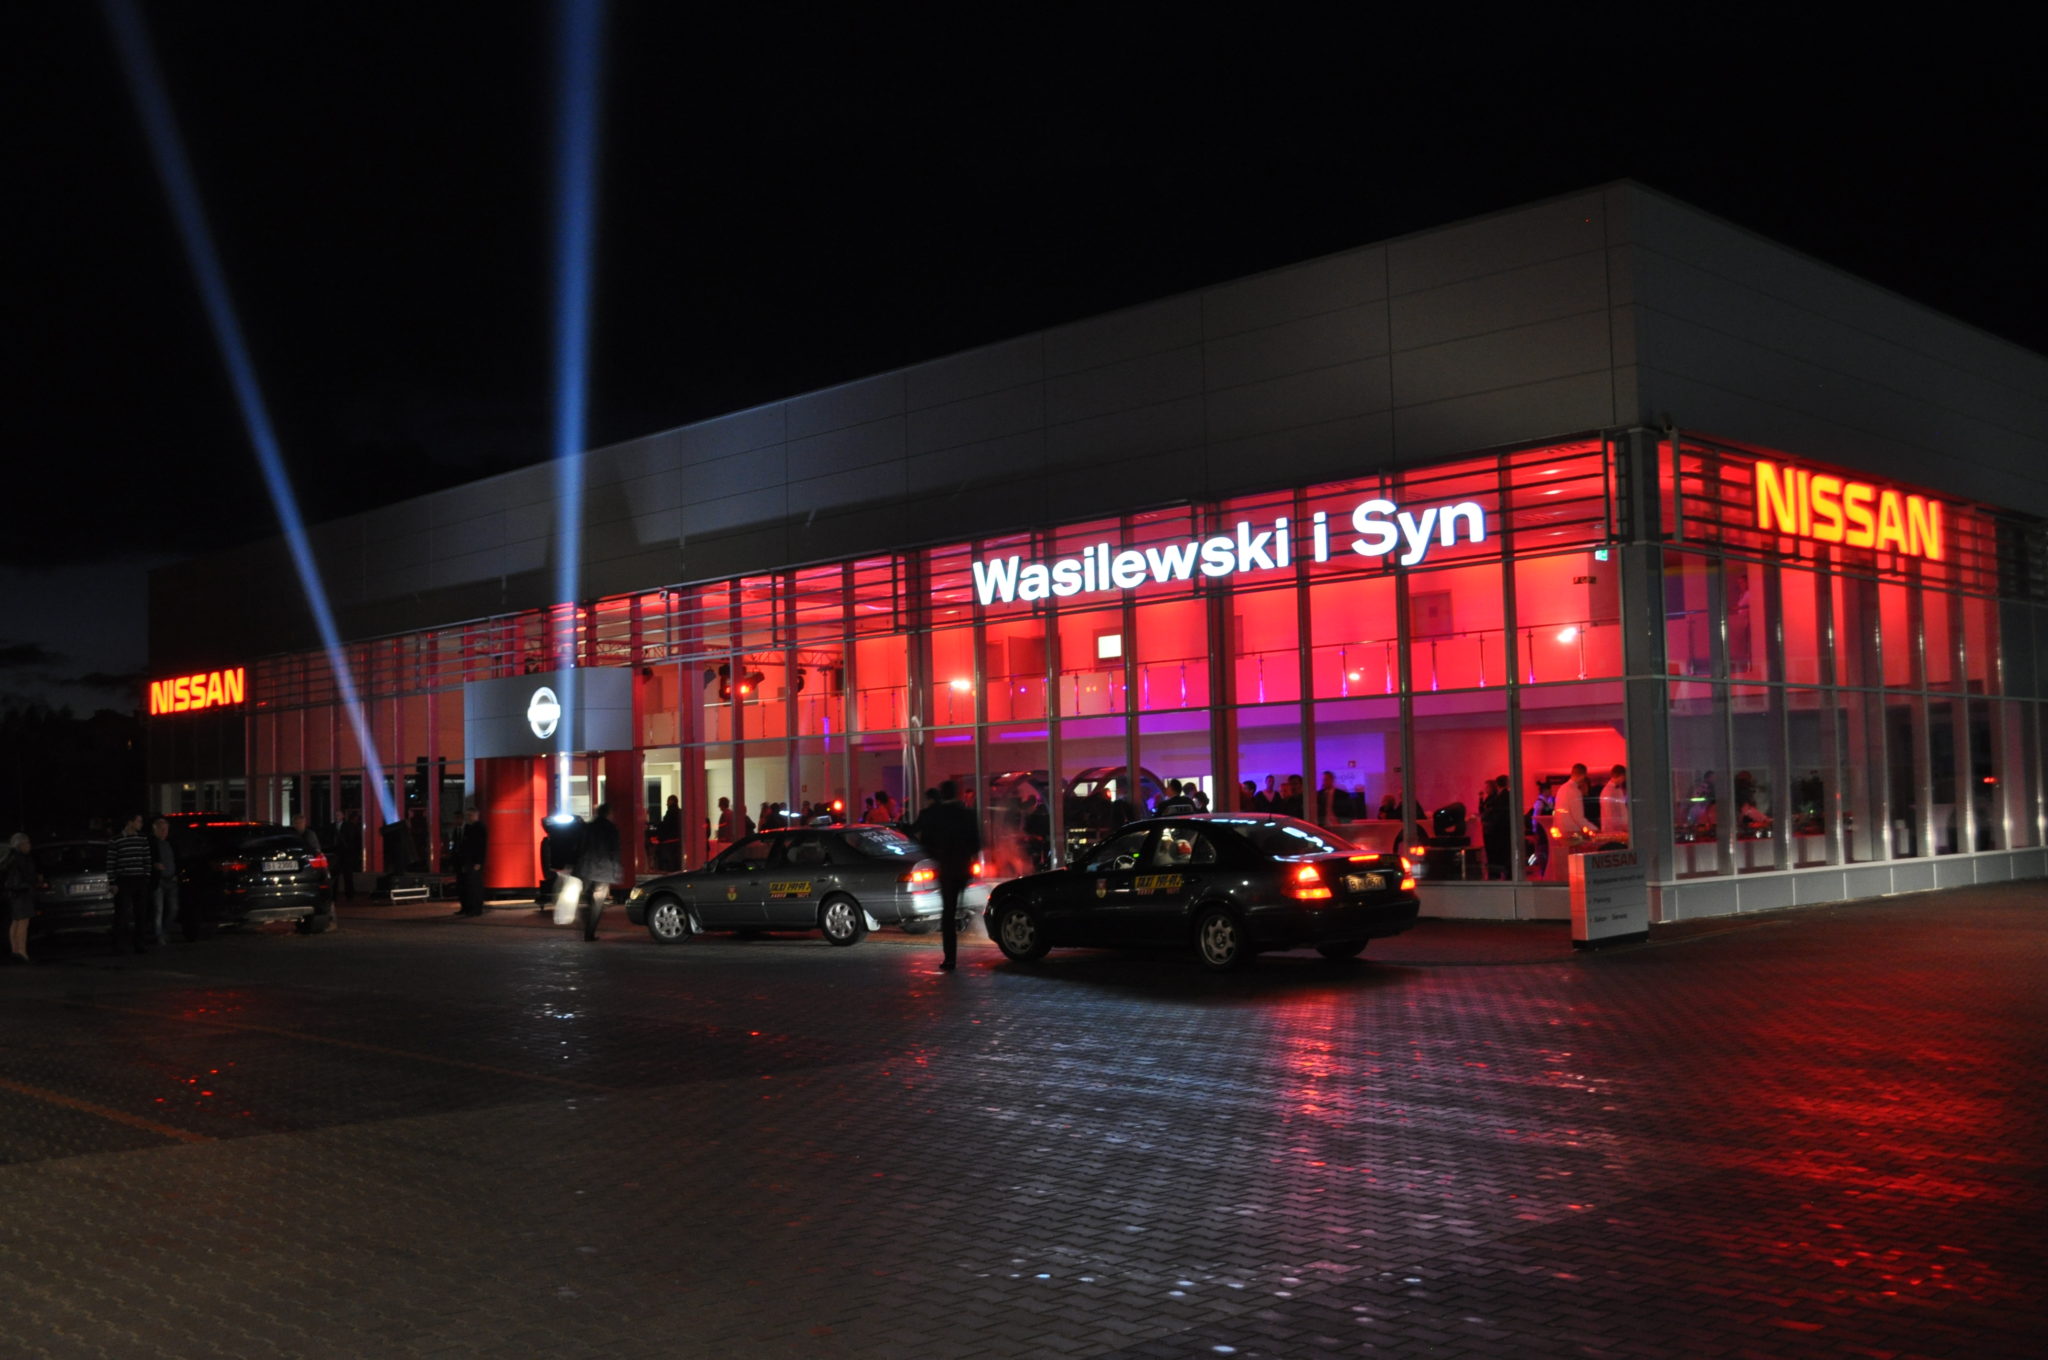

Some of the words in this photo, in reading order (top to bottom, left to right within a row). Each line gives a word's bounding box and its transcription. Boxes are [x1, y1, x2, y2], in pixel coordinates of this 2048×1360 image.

[1757, 462, 1940, 559] NISSAN
[973, 517, 1289, 605] Wasilewski
[1314, 512, 1327, 562] i
[1352, 499, 1485, 565] Syn
[152, 669, 243, 714] NISSAN
[1592, 853, 1638, 869] NISSAN
